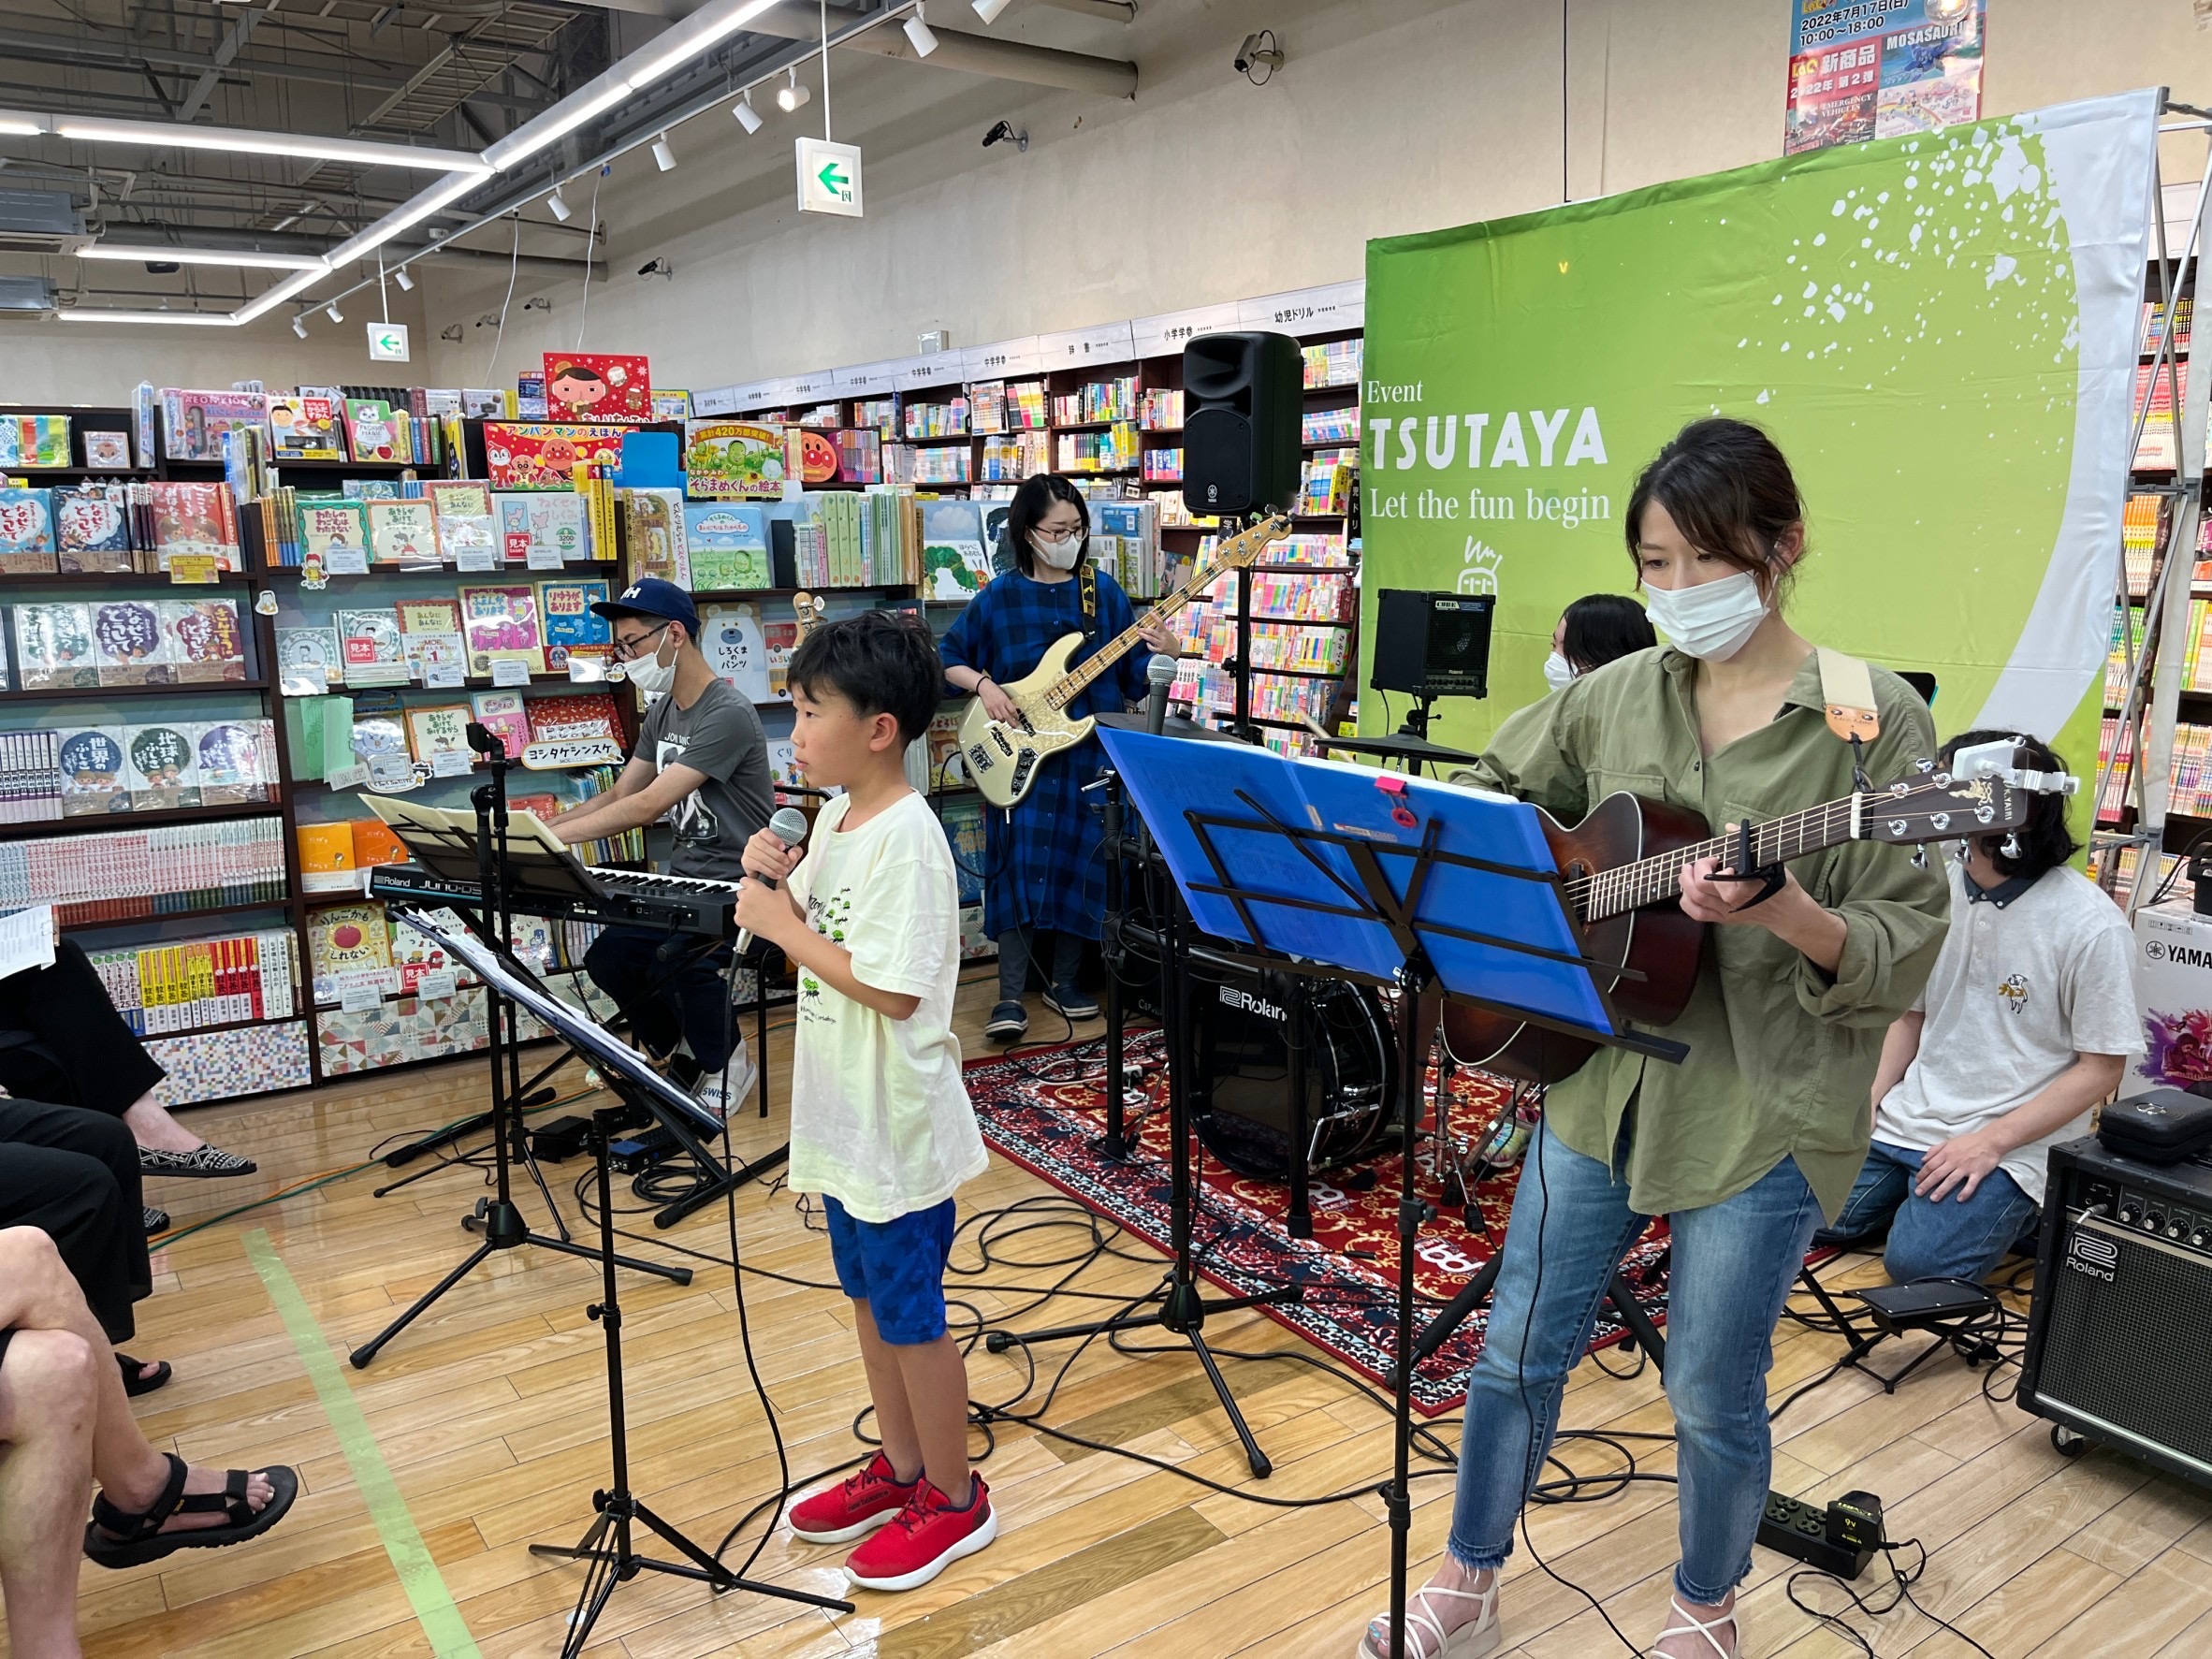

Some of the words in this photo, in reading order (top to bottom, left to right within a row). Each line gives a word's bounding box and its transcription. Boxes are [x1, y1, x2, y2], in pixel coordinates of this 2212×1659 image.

[1822, 44, 1875, 74] 新商品
[1274, 306, 1314, 323] 幼児ドリル
[1366, 380, 1423, 403] Event
[505, 425, 621, 439] アンパンマンのえほん
[1369, 407, 1608, 470] TSUTAYA
[690, 478, 781, 493] そらまめくんの絵本
[1370, 488, 1408, 518] Let
[1418, 488, 1459, 519] the
[1468, 488, 1515, 519] fun
[1526, 488, 1611, 529] begin
[508, 538, 528, 548] 見本
[472, 594, 505, 606] ふまんが
[548, 591, 580, 602] りゆうが
[550, 601, 582, 613] あります
[350, 643, 371, 652] 見本
[719, 646, 749, 655] しろくま
[721, 661, 747, 669] パンツ
[428, 713, 455, 722] あきらが
[89, 736, 110, 770] 世界の
[158, 731, 179, 764] 地球の
[529, 743, 613, 761] ヨシタケシンスケ
[75, 742, 91, 770] ふしぎ
[145, 742, 161, 770] ふしぎ
[385, 876, 411, 887] Roland
[320, 909, 369, 925] りんごかも
[329, 946, 369, 960] しれない
[1241, 992, 1288, 1021] Rolan
[2066, 1256, 2115, 1282] Roland
